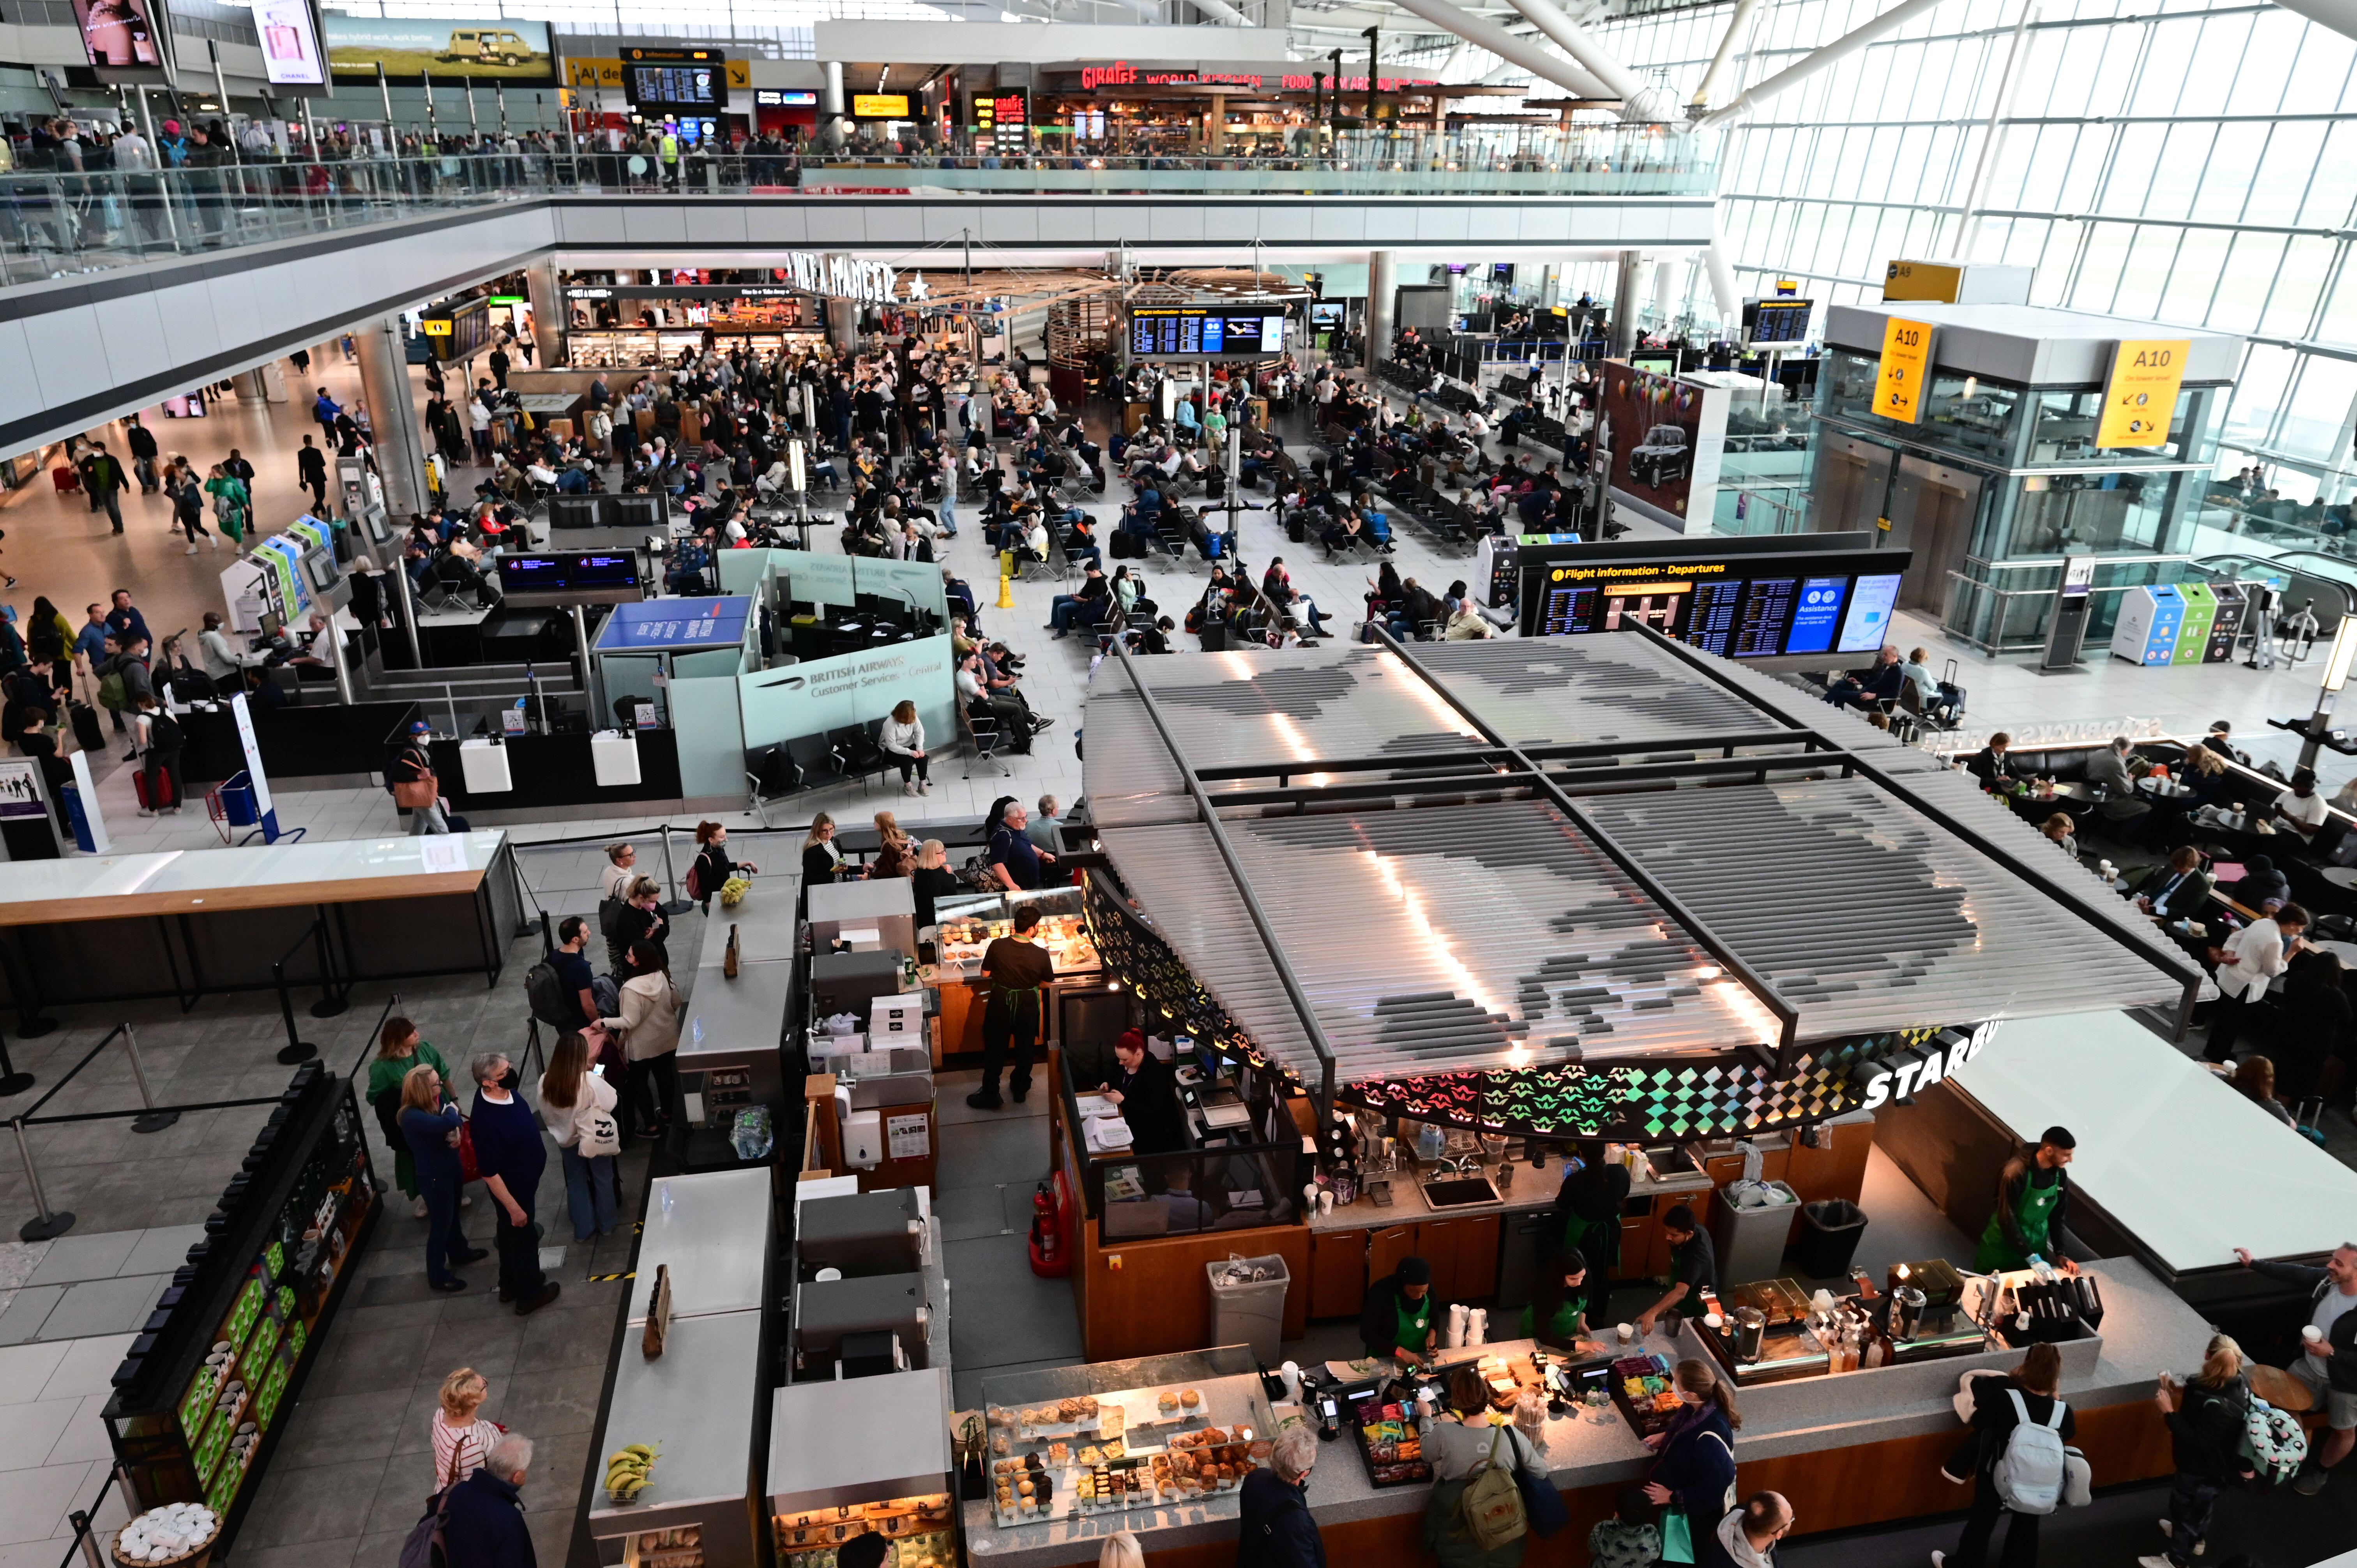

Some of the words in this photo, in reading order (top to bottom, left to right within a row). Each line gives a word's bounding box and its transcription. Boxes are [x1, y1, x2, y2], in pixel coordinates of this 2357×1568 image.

[1082, 61, 1138, 89] GIRAFFE
[1202, 74, 1262, 87] KITCHEN
[1282, 75, 1312, 89] FOOD
[995, 95, 1024, 111] GIRAFFE
[830, 256, 899, 304] MANGER
[1899, 266, 1912, 278] A9
[571, 289, 583, 298] PRET
[584, 290, 588, 298] A
[588, 289, 608, 298] MANGER
[687, 307, 709, 324] PRET
[1895, 328, 1919, 346] A10
[2133, 350, 2171, 367] A10
[1565, 568, 1595, 579] Flight
[1597, 566, 1659, 577] information
[1667, 563, 1725, 576] Departures
[698, 619, 715, 637] BRITISH
[809, 666, 856, 685] BRITISH
[858, 655, 905, 674] AIRWAYS
[811, 680, 858, 698] Customer
[861, 672, 900, 688] Services
[909, 661, 942, 677] Central
